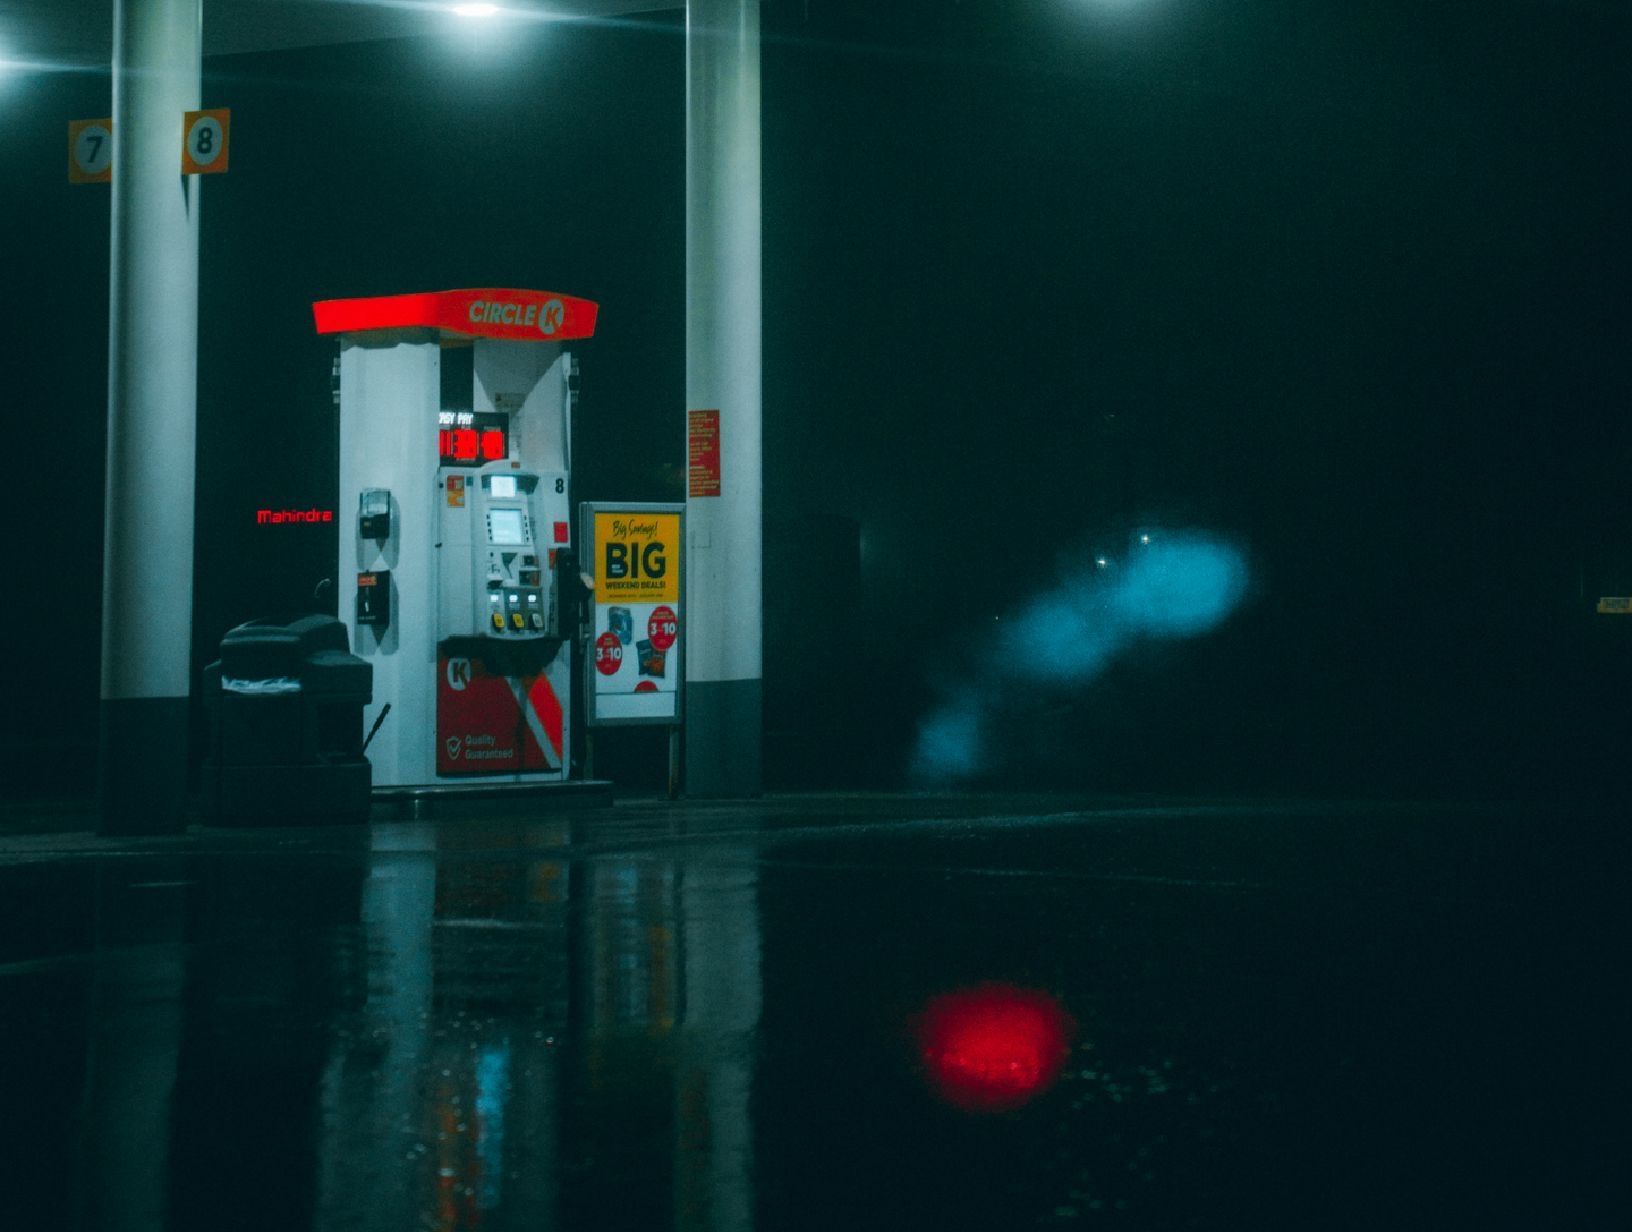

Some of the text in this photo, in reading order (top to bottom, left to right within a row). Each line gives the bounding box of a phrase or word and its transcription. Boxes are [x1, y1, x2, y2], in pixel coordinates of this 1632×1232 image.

[197, 127, 212, 154] 8
[86, 135, 103, 163] 7
[469, 299, 564, 335] CIRCLE K
[439, 411, 456, 425] ASY
[555, 478, 564, 494] 8
[257, 509, 332, 523] Mahindra
[606, 542, 666, 579] BIG
[465, 734, 495, 746] Quality
[465, 749, 513, 760] Guaranteed
